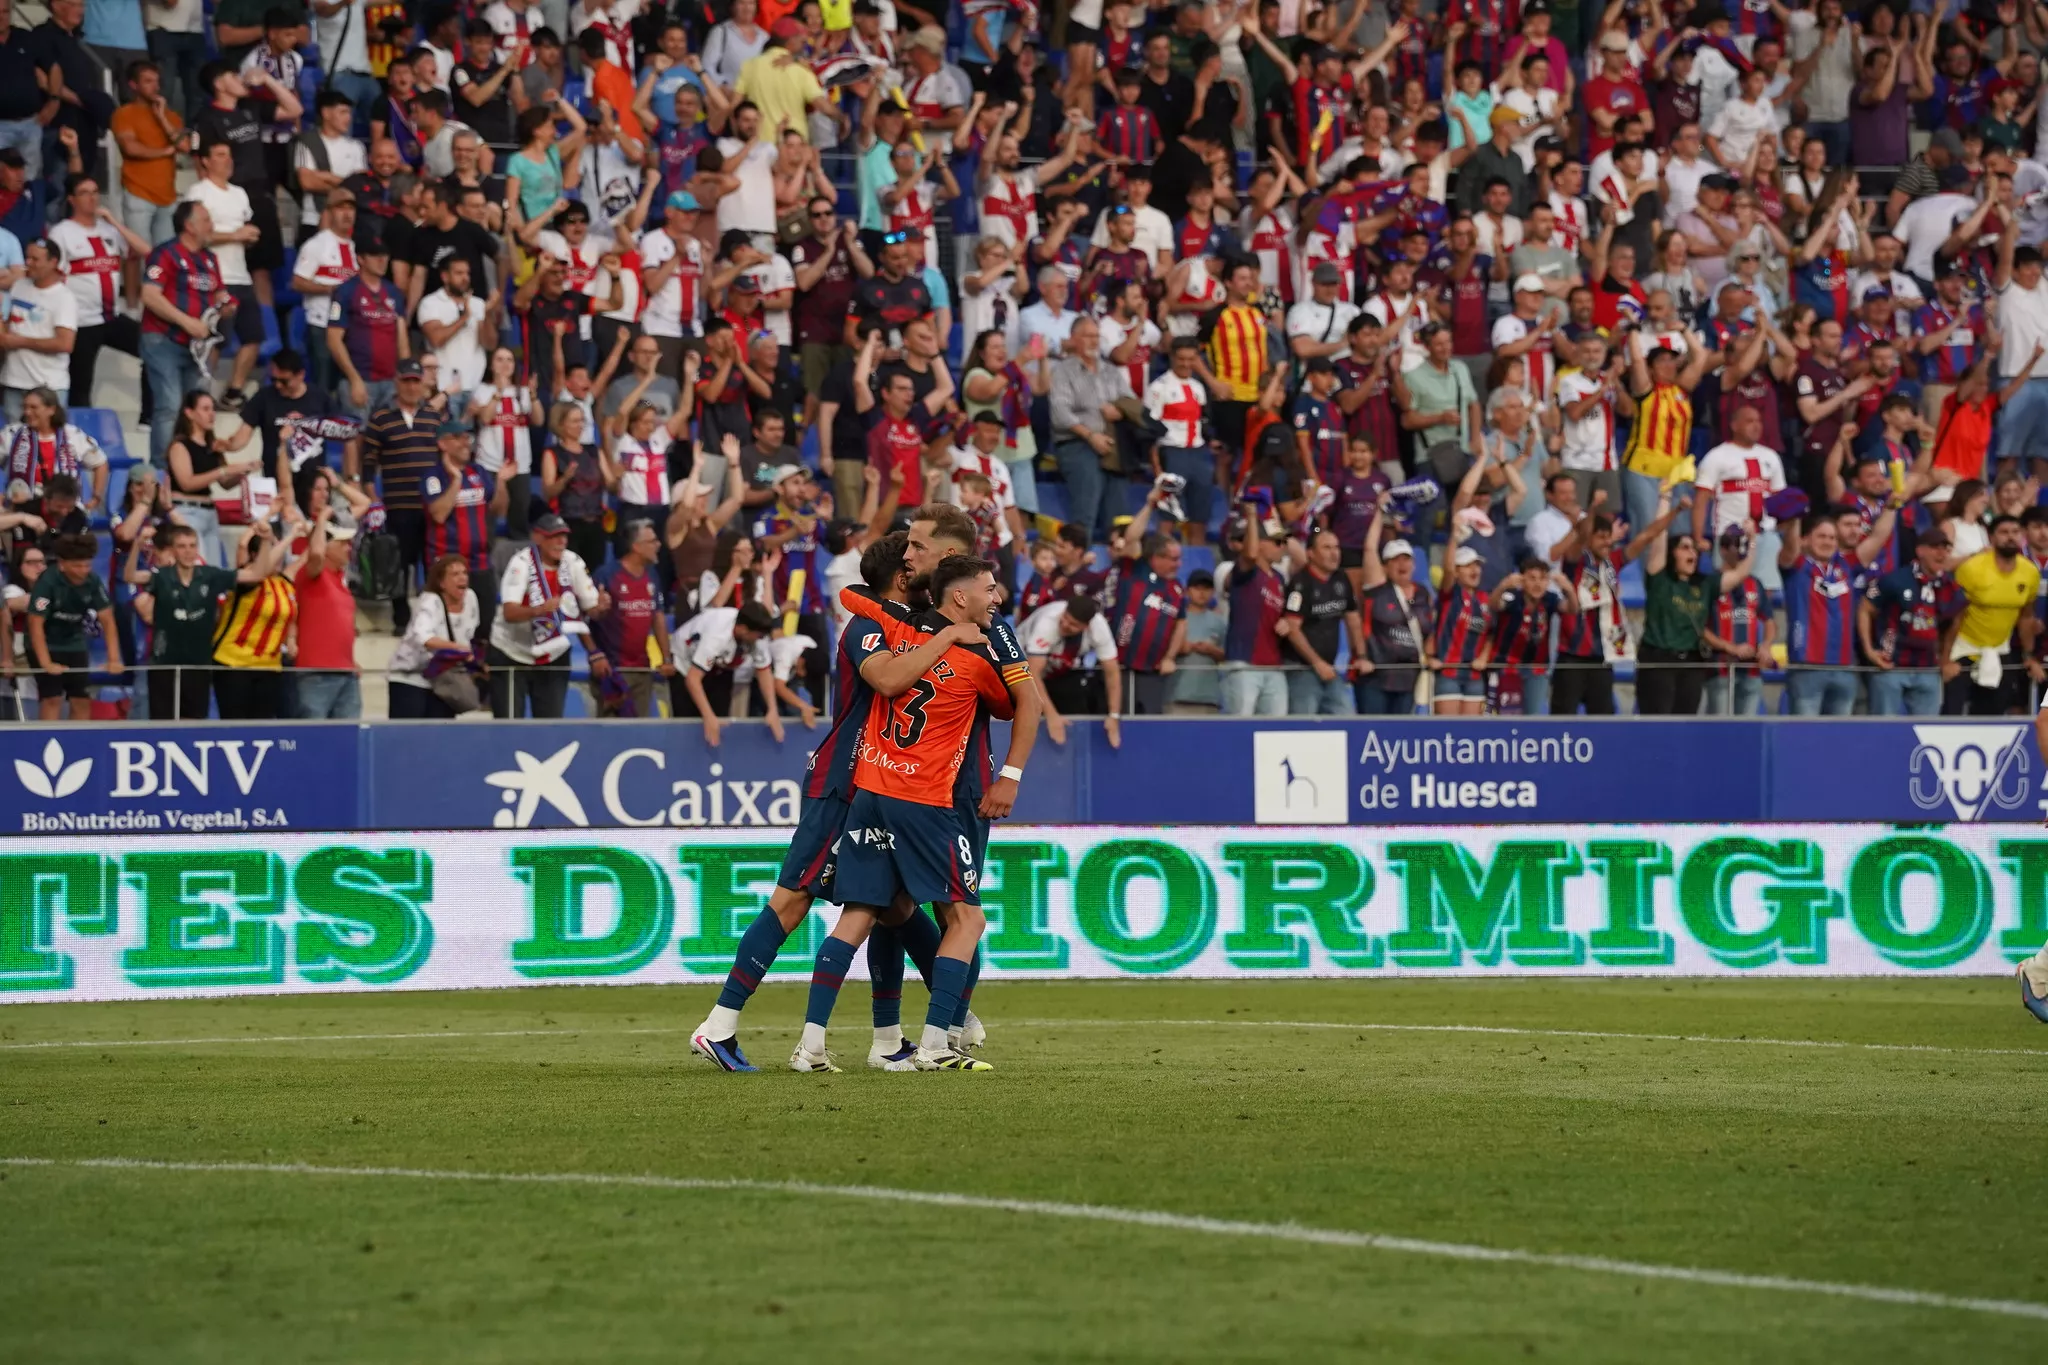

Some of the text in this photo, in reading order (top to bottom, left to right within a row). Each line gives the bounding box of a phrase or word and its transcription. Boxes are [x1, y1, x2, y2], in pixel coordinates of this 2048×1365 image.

[109, 740, 274, 798] BNV
[1360, 728, 1594, 774] Ayuntamiento
[602, 747, 814, 827] Caixa
[1360, 773, 1537, 809] de Huesca
[22, 808, 289, 832] BioNutrición Vegetal, S.A
[958, 834, 973, 865] 8
[905, 823, 2048, 971] HORMIGÓ
